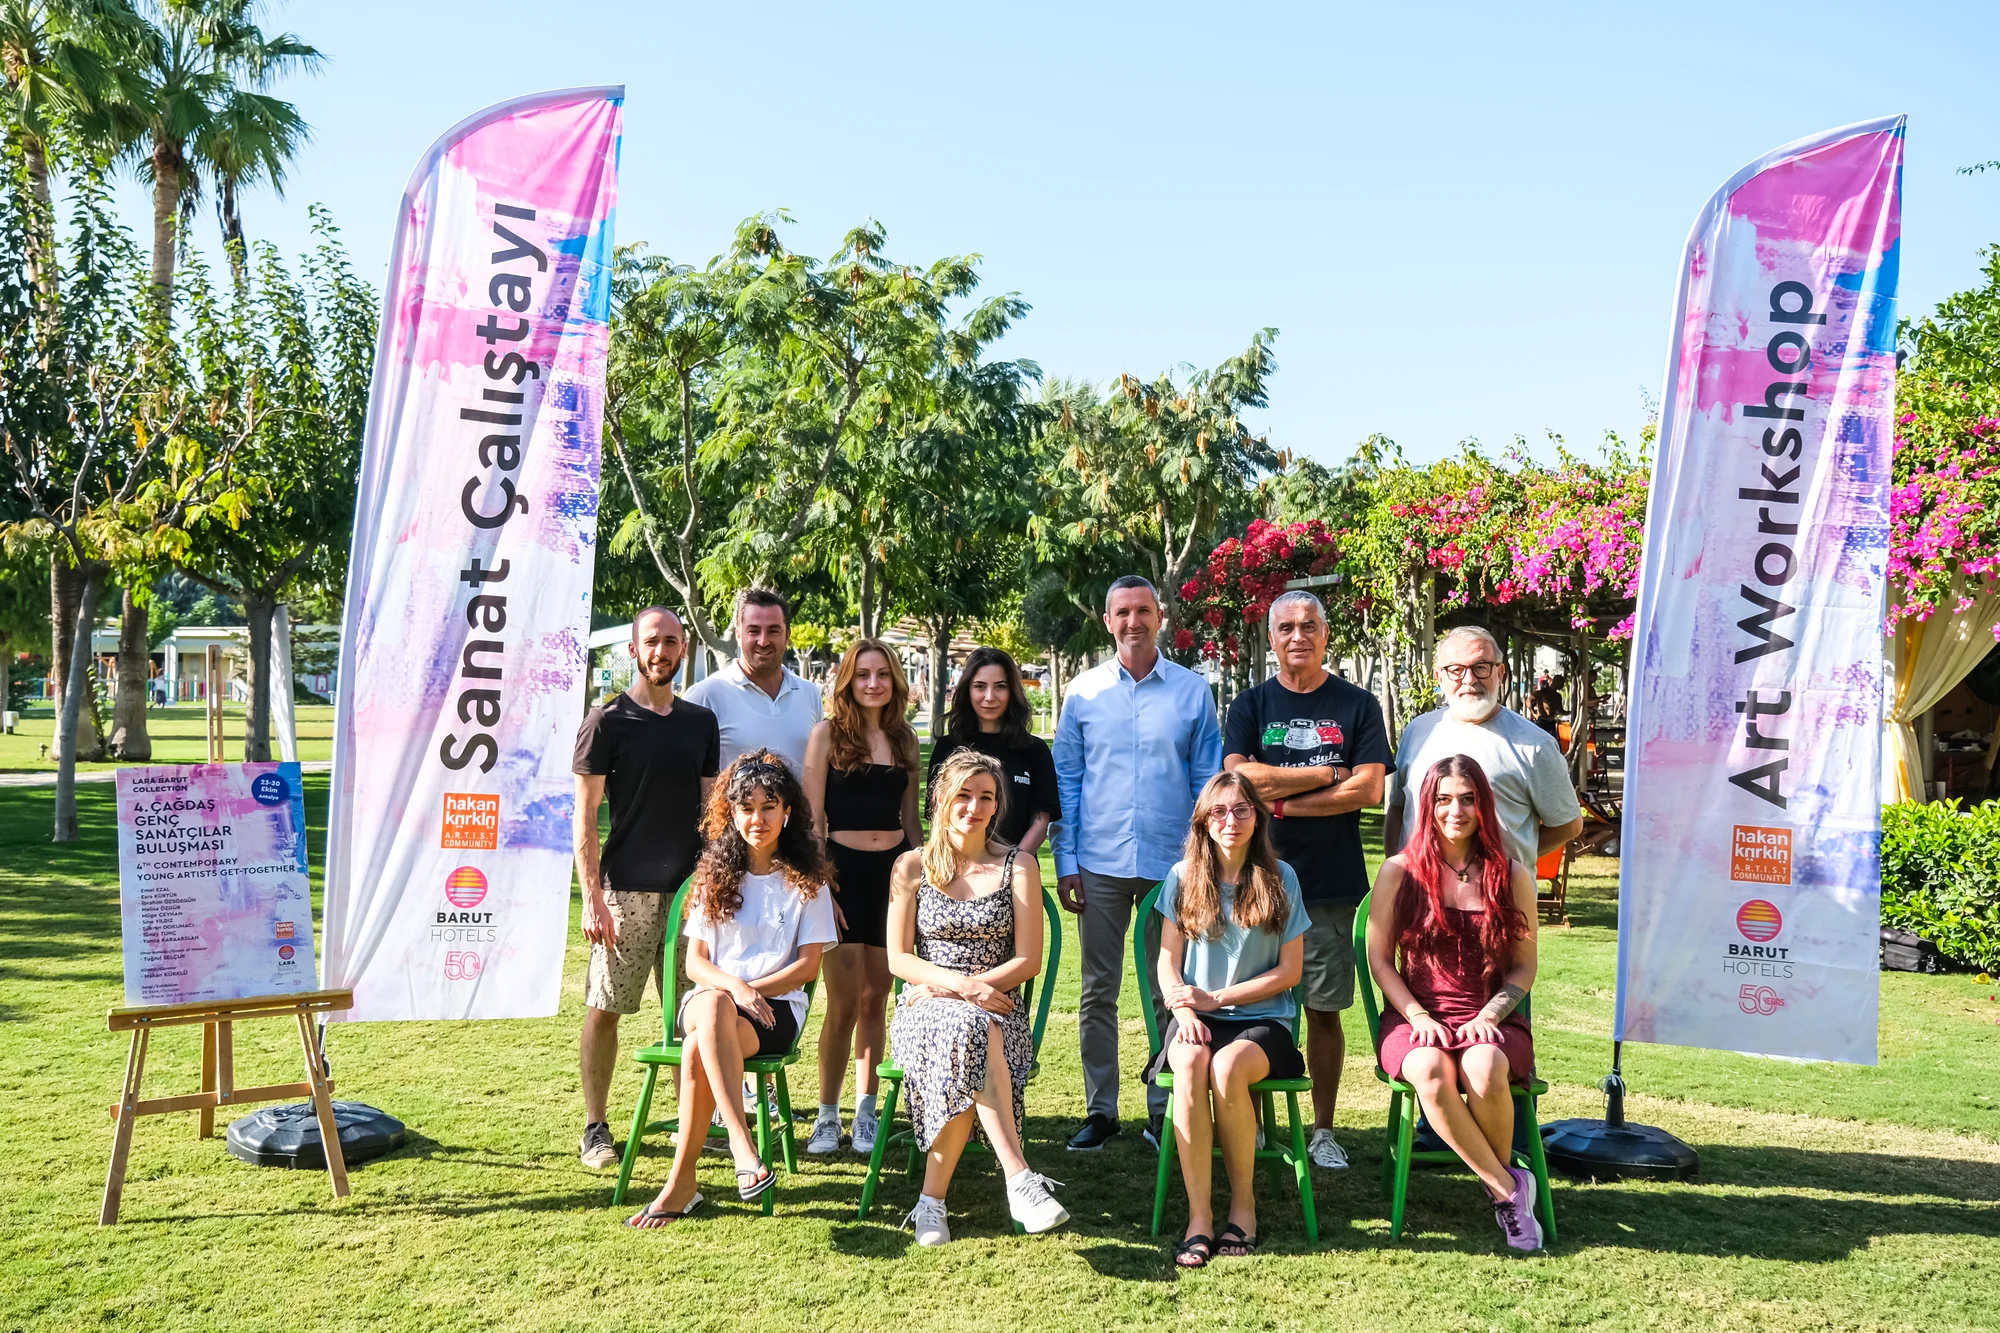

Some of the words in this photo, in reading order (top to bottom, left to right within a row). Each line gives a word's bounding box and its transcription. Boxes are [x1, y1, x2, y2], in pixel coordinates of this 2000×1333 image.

[460, 203, 547, 530] Çalıştayı
[1735, 280, 1827, 665] Workshop
[440, 557, 511, 775] Sanat
[1728, 690, 1792, 810] Art
[1308, 751, 1341, 766] Style
[158, 776, 188, 784] BARUT
[260, 779, 281, 787] 23-30
[133, 785, 188, 793] COLLECTION
[134, 802, 148, 813] 4.
[150, 797, 216, 815] ÇAĞDAŞ
[446, 796, 496, 811] hakan
[134, 814, 180, 828] GENÇ
[135, 825, 232, 841] SANATÇILAR
[1736, 828, 1788, 846] hakan
[136, 839, 224, 855] BULUŞMASI
[444, 839, 493, 848] COMMUNITY
[153, 858, 238, 870] CONTEMPORARY
[137, 872, 175, 881] YOUNG
[177, 869, 217, 879] ARTISTS
[220, 864, 296, 877] GET-TOGETHER
[1734, 872, 1787, 883] COMMUNITY
[436, 912, 493, 924] BARUT
[430, 929, 496, 942] HOTELS
[1728, 944, 1789, 960] BARUT
[444, 951, 480, 981] 50
[1723, 960, 1793, 979] HOTELS
[1739, 984, 1777, 1016] 50
